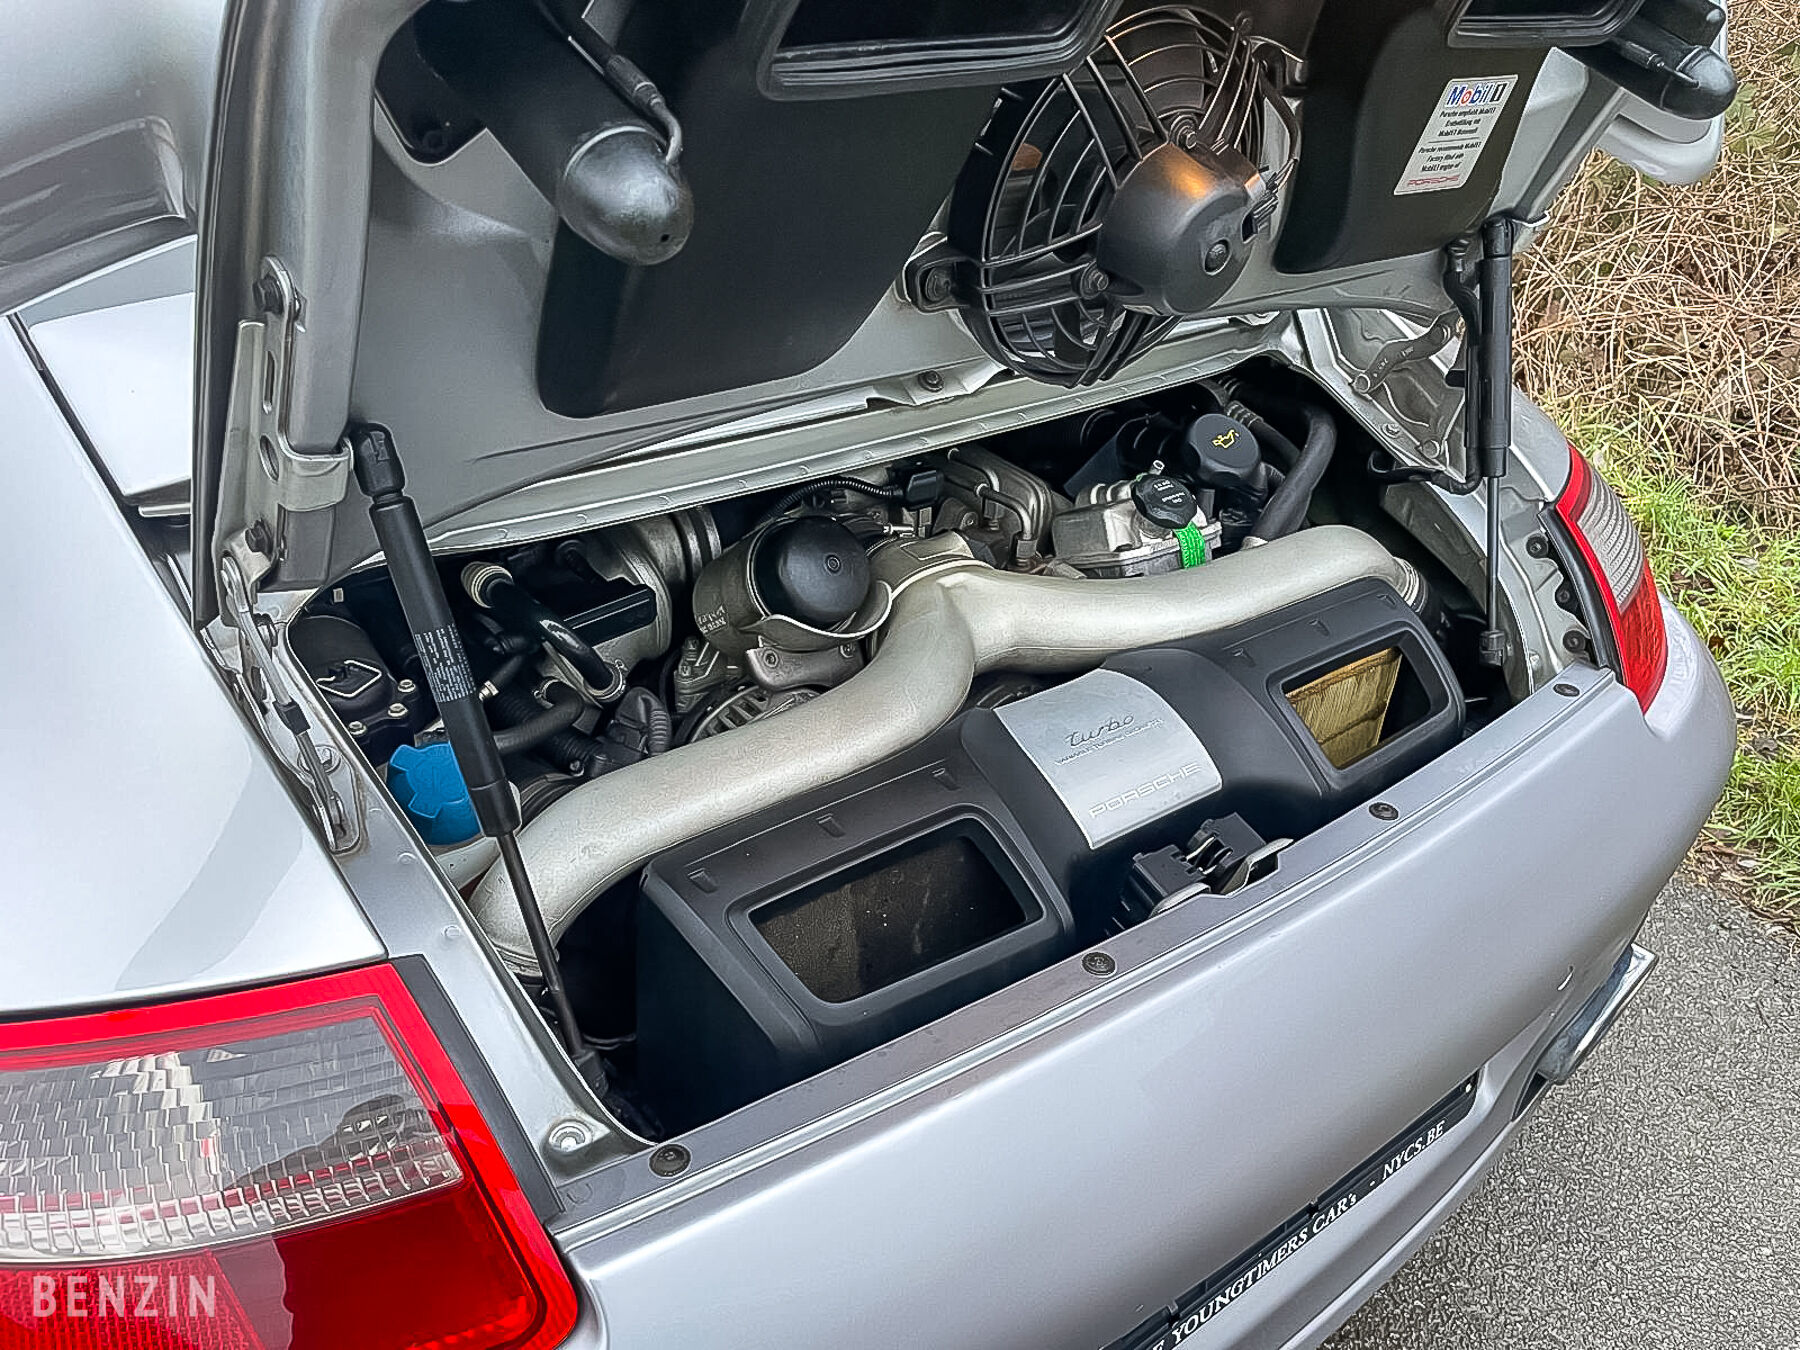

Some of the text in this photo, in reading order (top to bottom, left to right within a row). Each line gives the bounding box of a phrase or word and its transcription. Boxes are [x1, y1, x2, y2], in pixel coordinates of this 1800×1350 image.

[1447, 84, 1493, 105] Mobil
[1065, 715, 1135, 748] turbo
[1089, 763, 1201, 819] PORSCHE
[1172, 1227, 1308, 1344] YOUNGTIMERS
[1382, 1120, 1445, 1180] NYCS.BE
